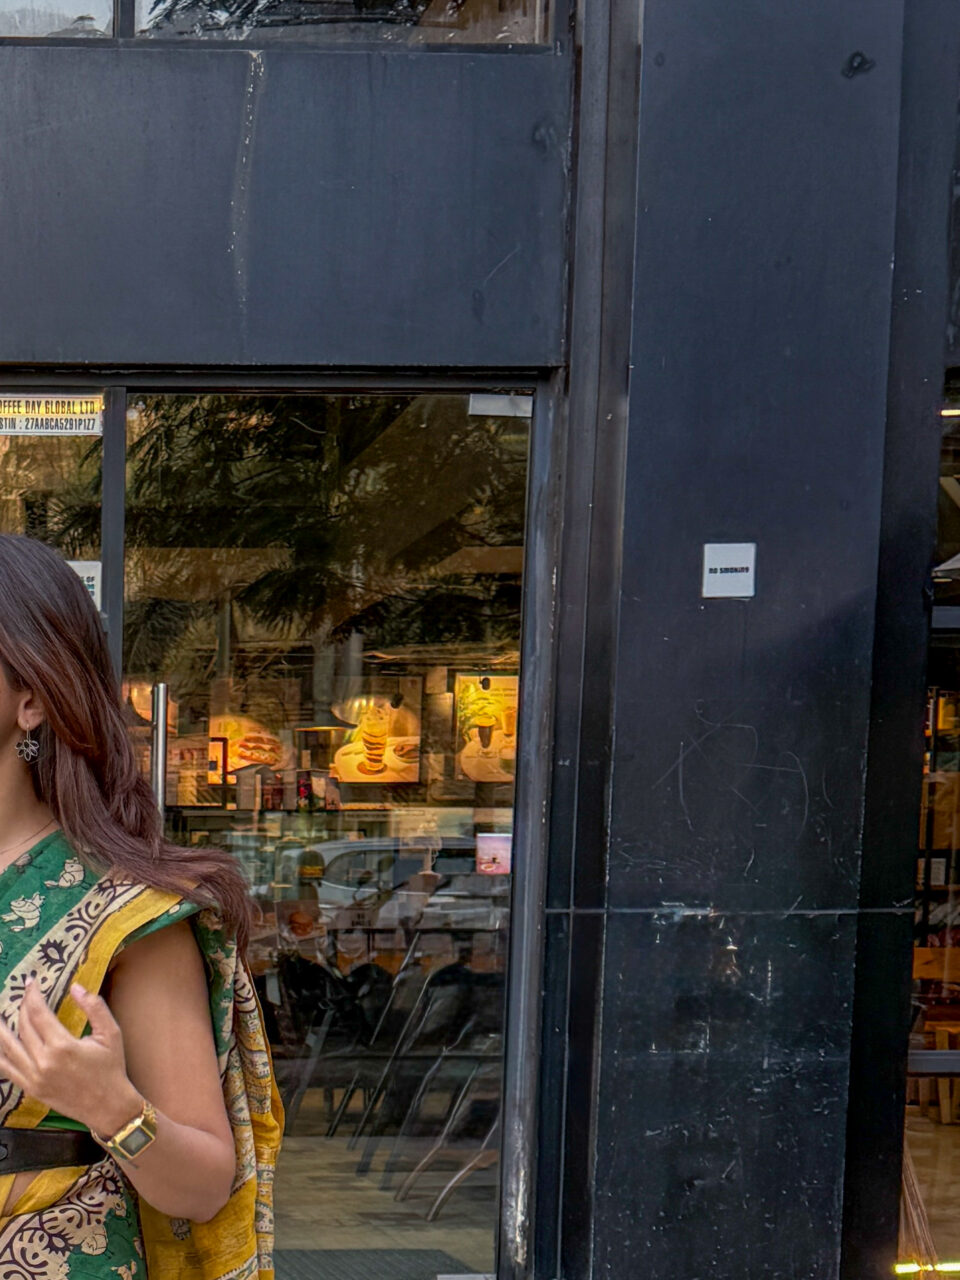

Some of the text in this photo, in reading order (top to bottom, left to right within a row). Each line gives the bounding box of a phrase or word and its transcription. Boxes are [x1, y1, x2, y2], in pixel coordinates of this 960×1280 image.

[25, 400, 42, 414] DAY
[45, 400, 77, 415] GLOBAL
[79, 401, 98, 415] LTD.
